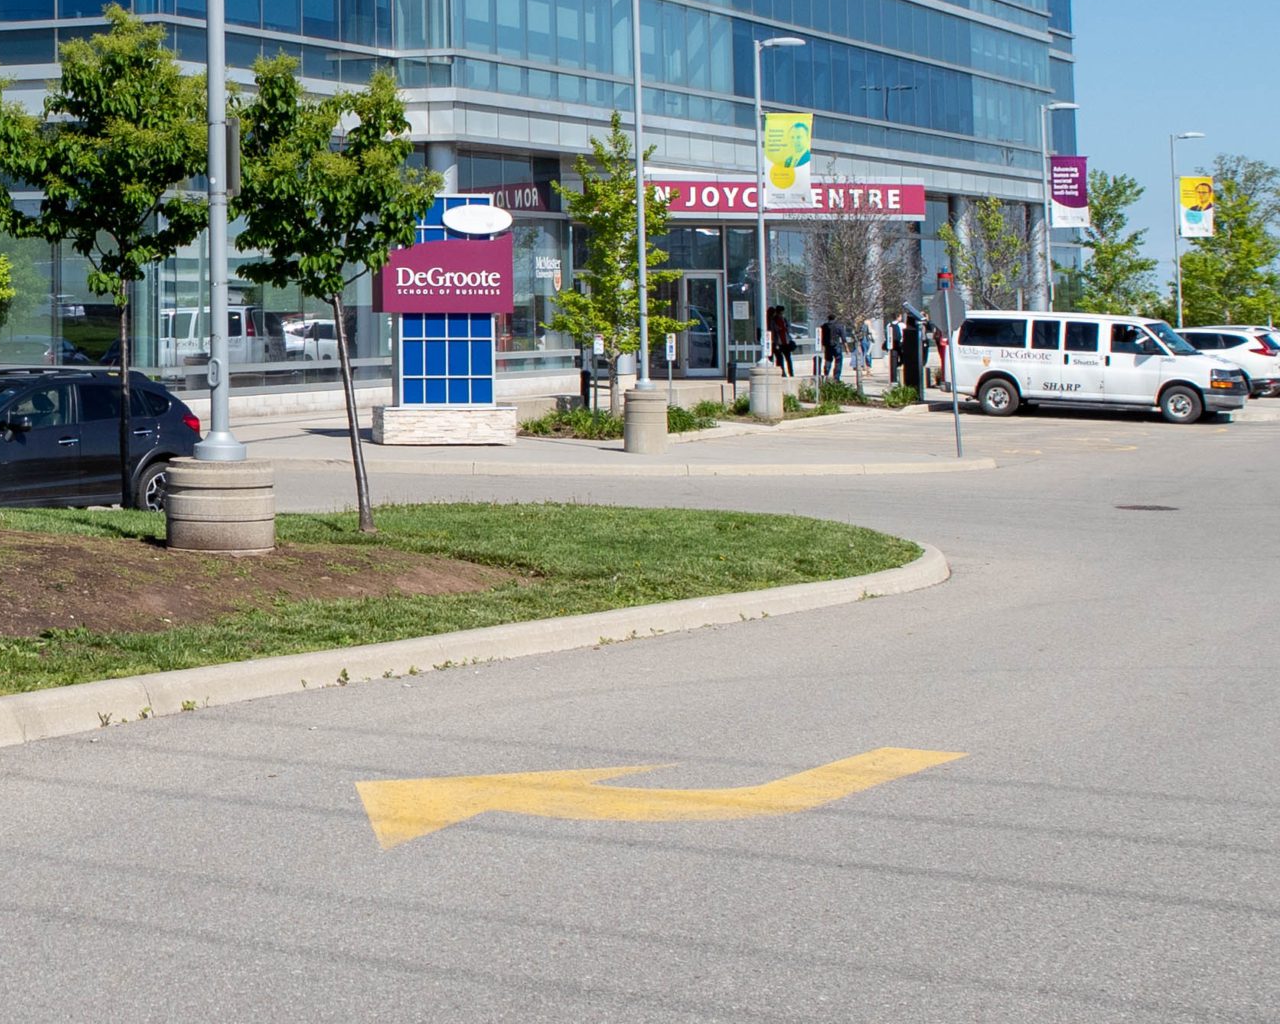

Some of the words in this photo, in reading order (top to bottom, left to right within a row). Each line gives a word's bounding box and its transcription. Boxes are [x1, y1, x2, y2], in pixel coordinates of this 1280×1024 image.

[685, 186, 767, 208] JOYC
[811, 185, 901, 210] ENTRE
[535, 256, 561, 269] McMaster
[396, 267, 500, 287] DeGroote
[1000, 349, 1052, 361] DeGroote
[1042, 381, 1081, 392] SHARP
